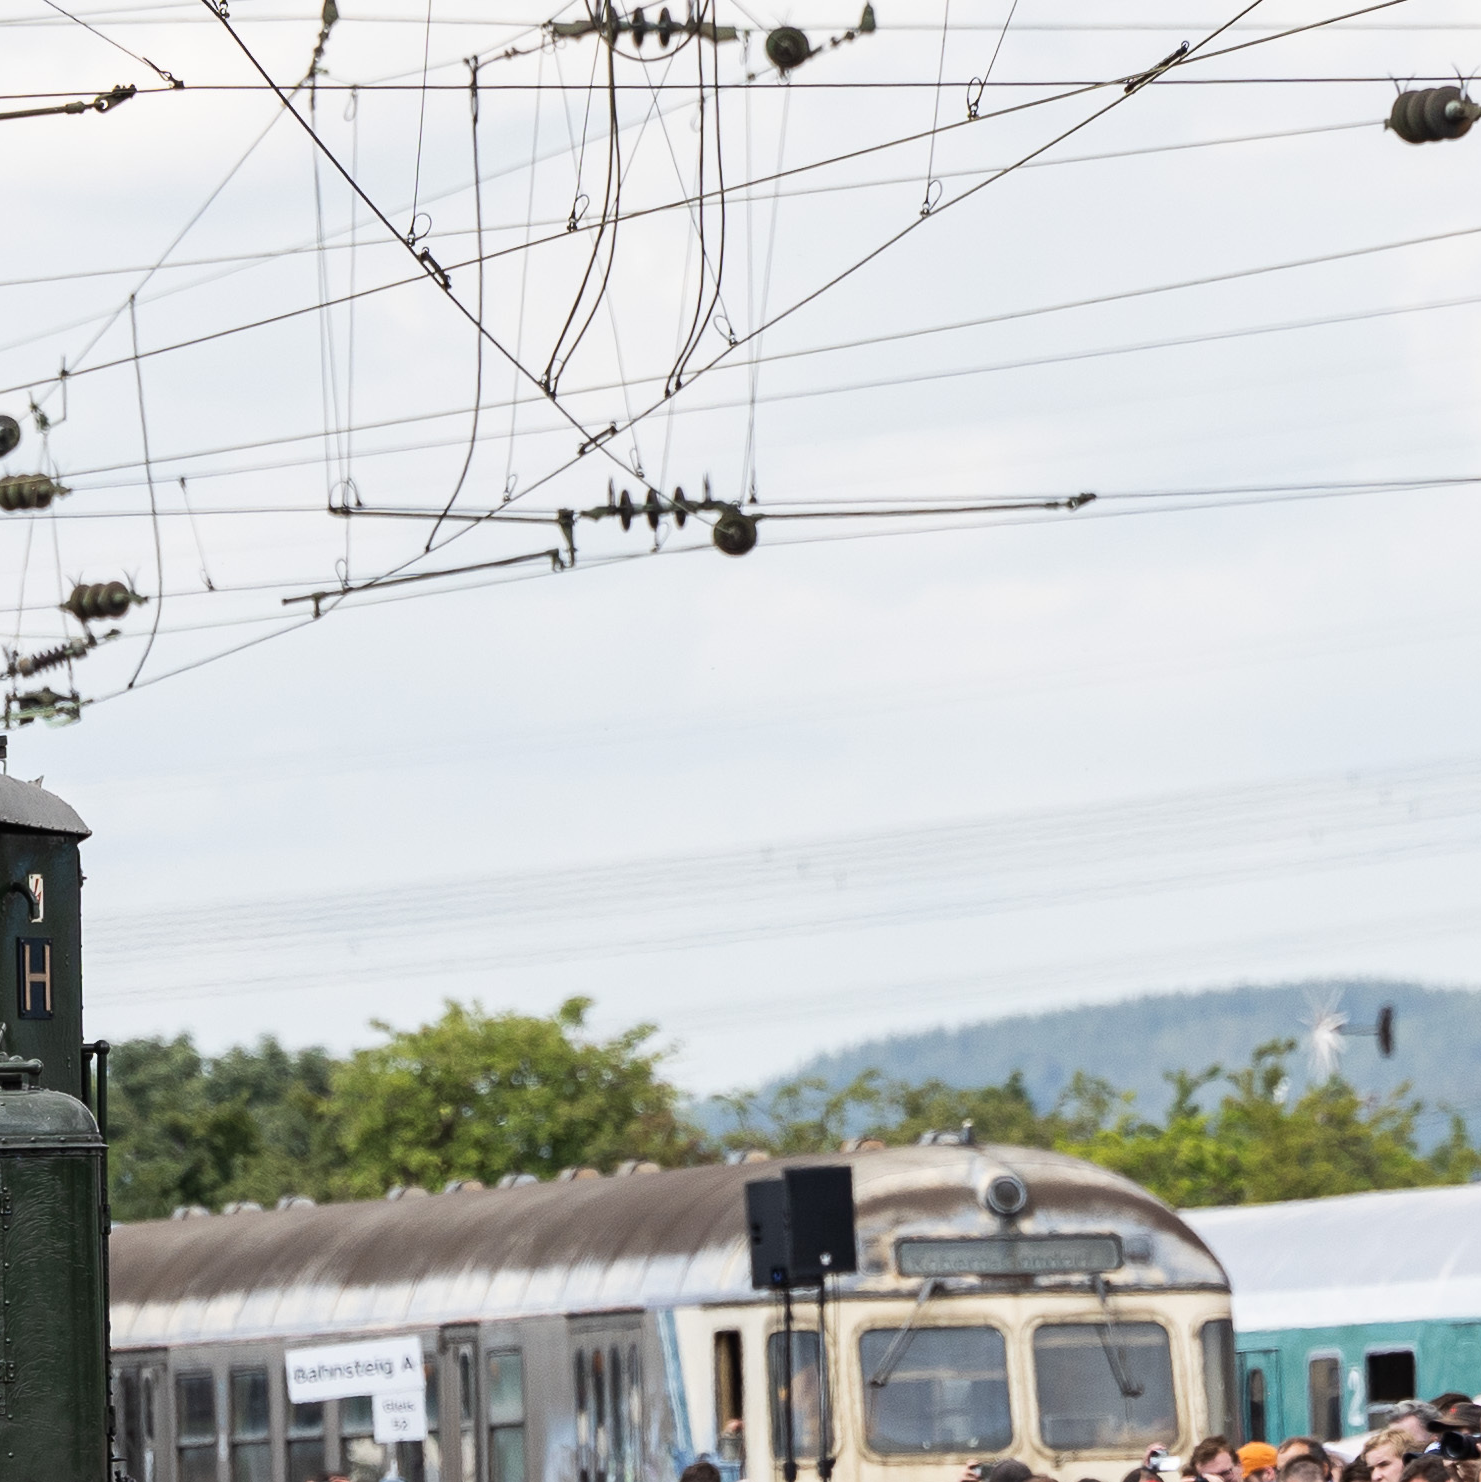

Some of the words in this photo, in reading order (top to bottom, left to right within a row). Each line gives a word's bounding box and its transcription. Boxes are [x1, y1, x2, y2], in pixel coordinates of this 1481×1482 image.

[25, 944, 51, 1011] H
[293, 1359, 394, 1384] Bahnsteig
[1348, 1366, 1365, 1427] 2
